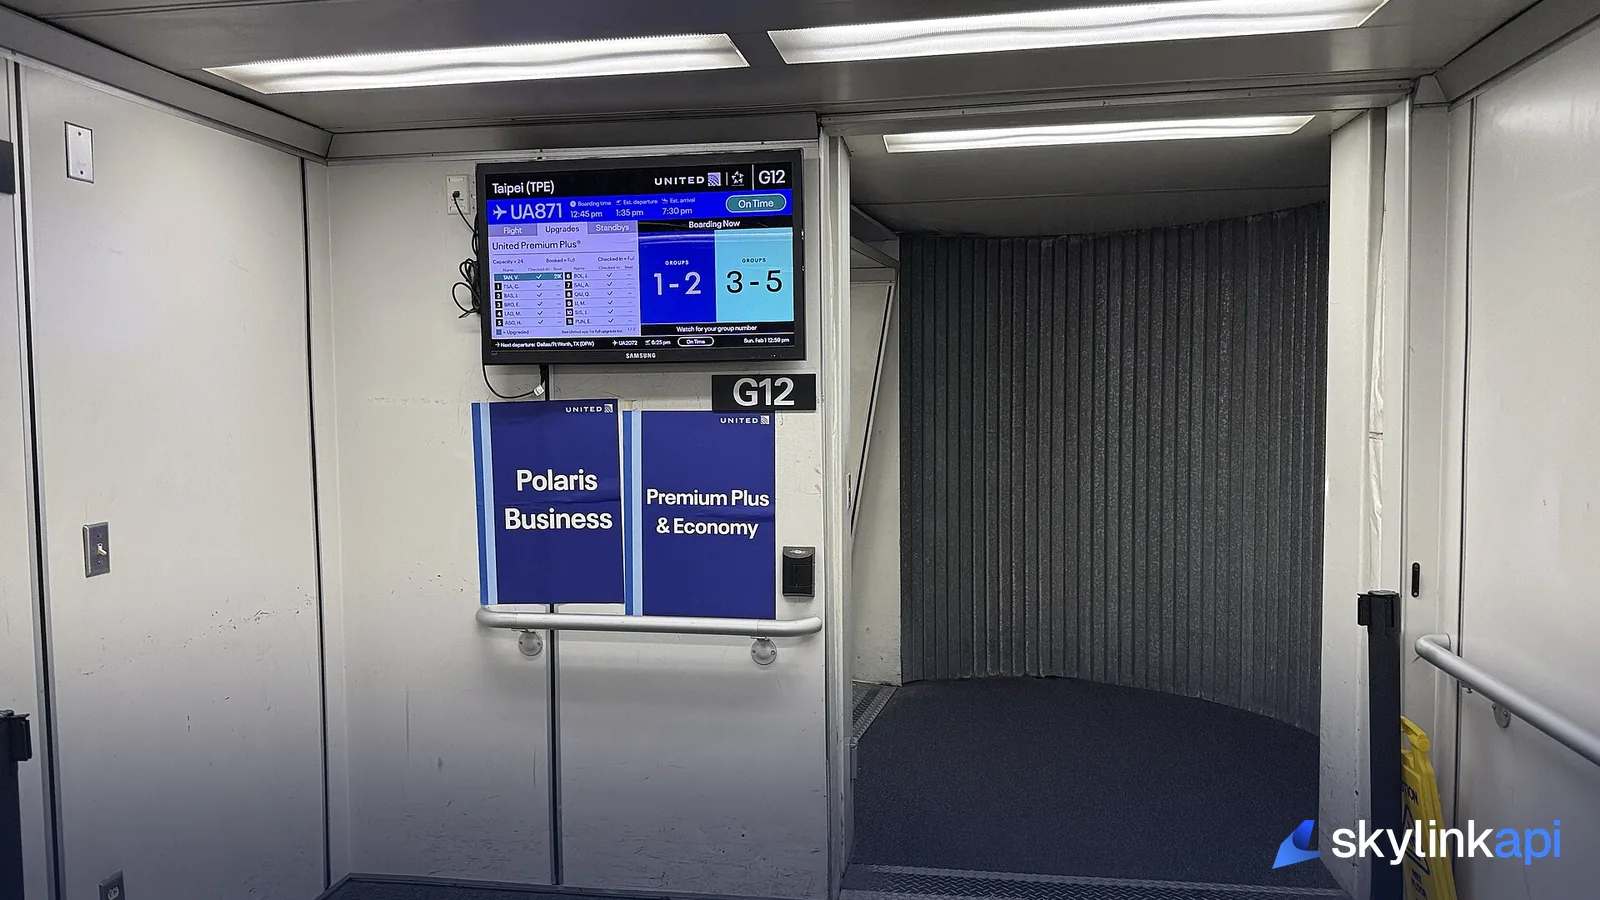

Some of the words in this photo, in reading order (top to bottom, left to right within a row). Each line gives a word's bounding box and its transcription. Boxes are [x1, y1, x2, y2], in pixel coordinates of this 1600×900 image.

[654, 176, 704, 185] UNITED
[758, 170, 786, 184] G12
[492, 182, 524, 196] Taipei
[526, 180, 554, 195] (TPE)
[738, 200, 751, 208] On
[753, 199, 774, 208] Time
[510, 203, 562, 220] UA871
[503, 226, 523, 235] Flight
[595, 223, 630, 232] Standbys
[688, 220, 722, 229] Boarding
[492, 242, 519, 250] United
[521, 241, 558, 249] Premium
[732, 377, 795, 407] G12
[516, 469, 597, 491] Polaris
[646, 489, 727, 506] Premium
[731, 490, 770, 507] Plus
[504, 507, 613, 530] Business
[656, 517, 670, 534] &
[673, 518, 759, 539] Economy
